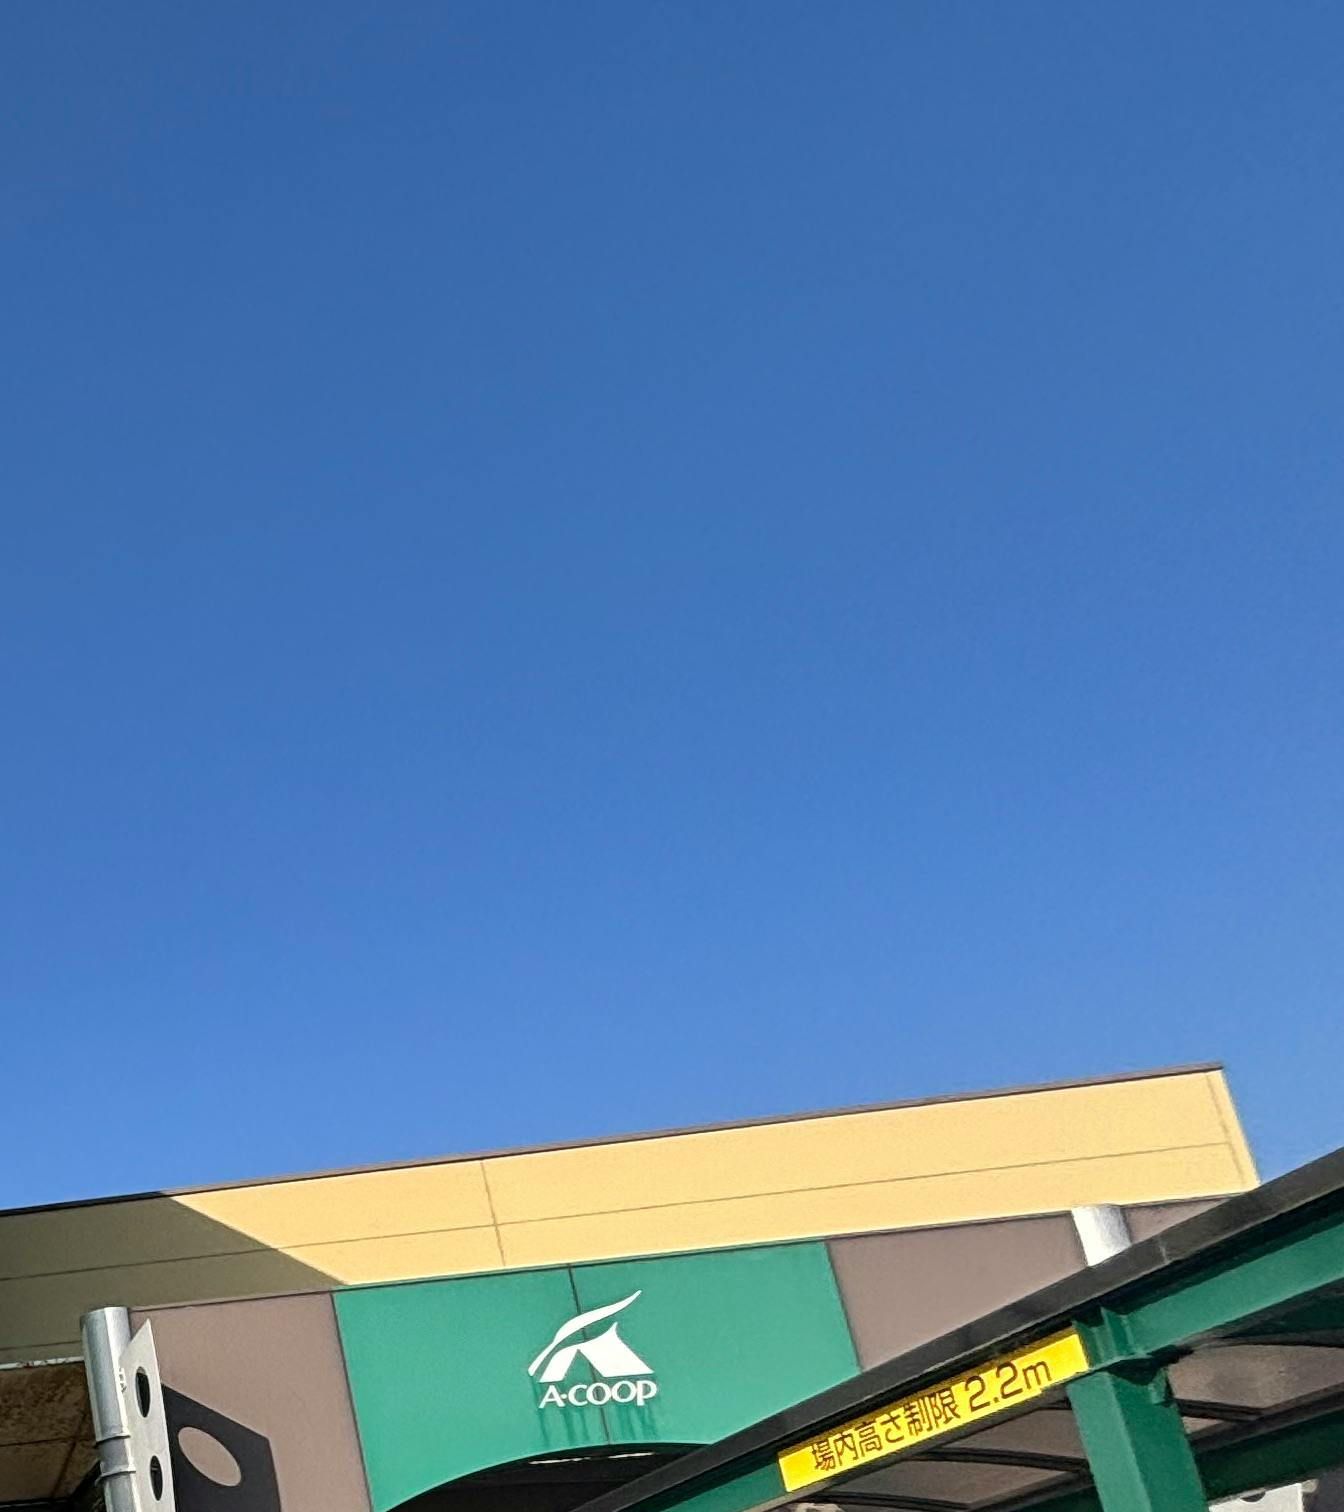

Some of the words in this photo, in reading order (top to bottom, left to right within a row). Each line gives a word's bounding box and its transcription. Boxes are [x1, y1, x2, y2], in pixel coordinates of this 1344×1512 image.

[811, 1386, 960, 1472] 場内高さ制限
[963, 1359, 1053, 1412] 2.2m
